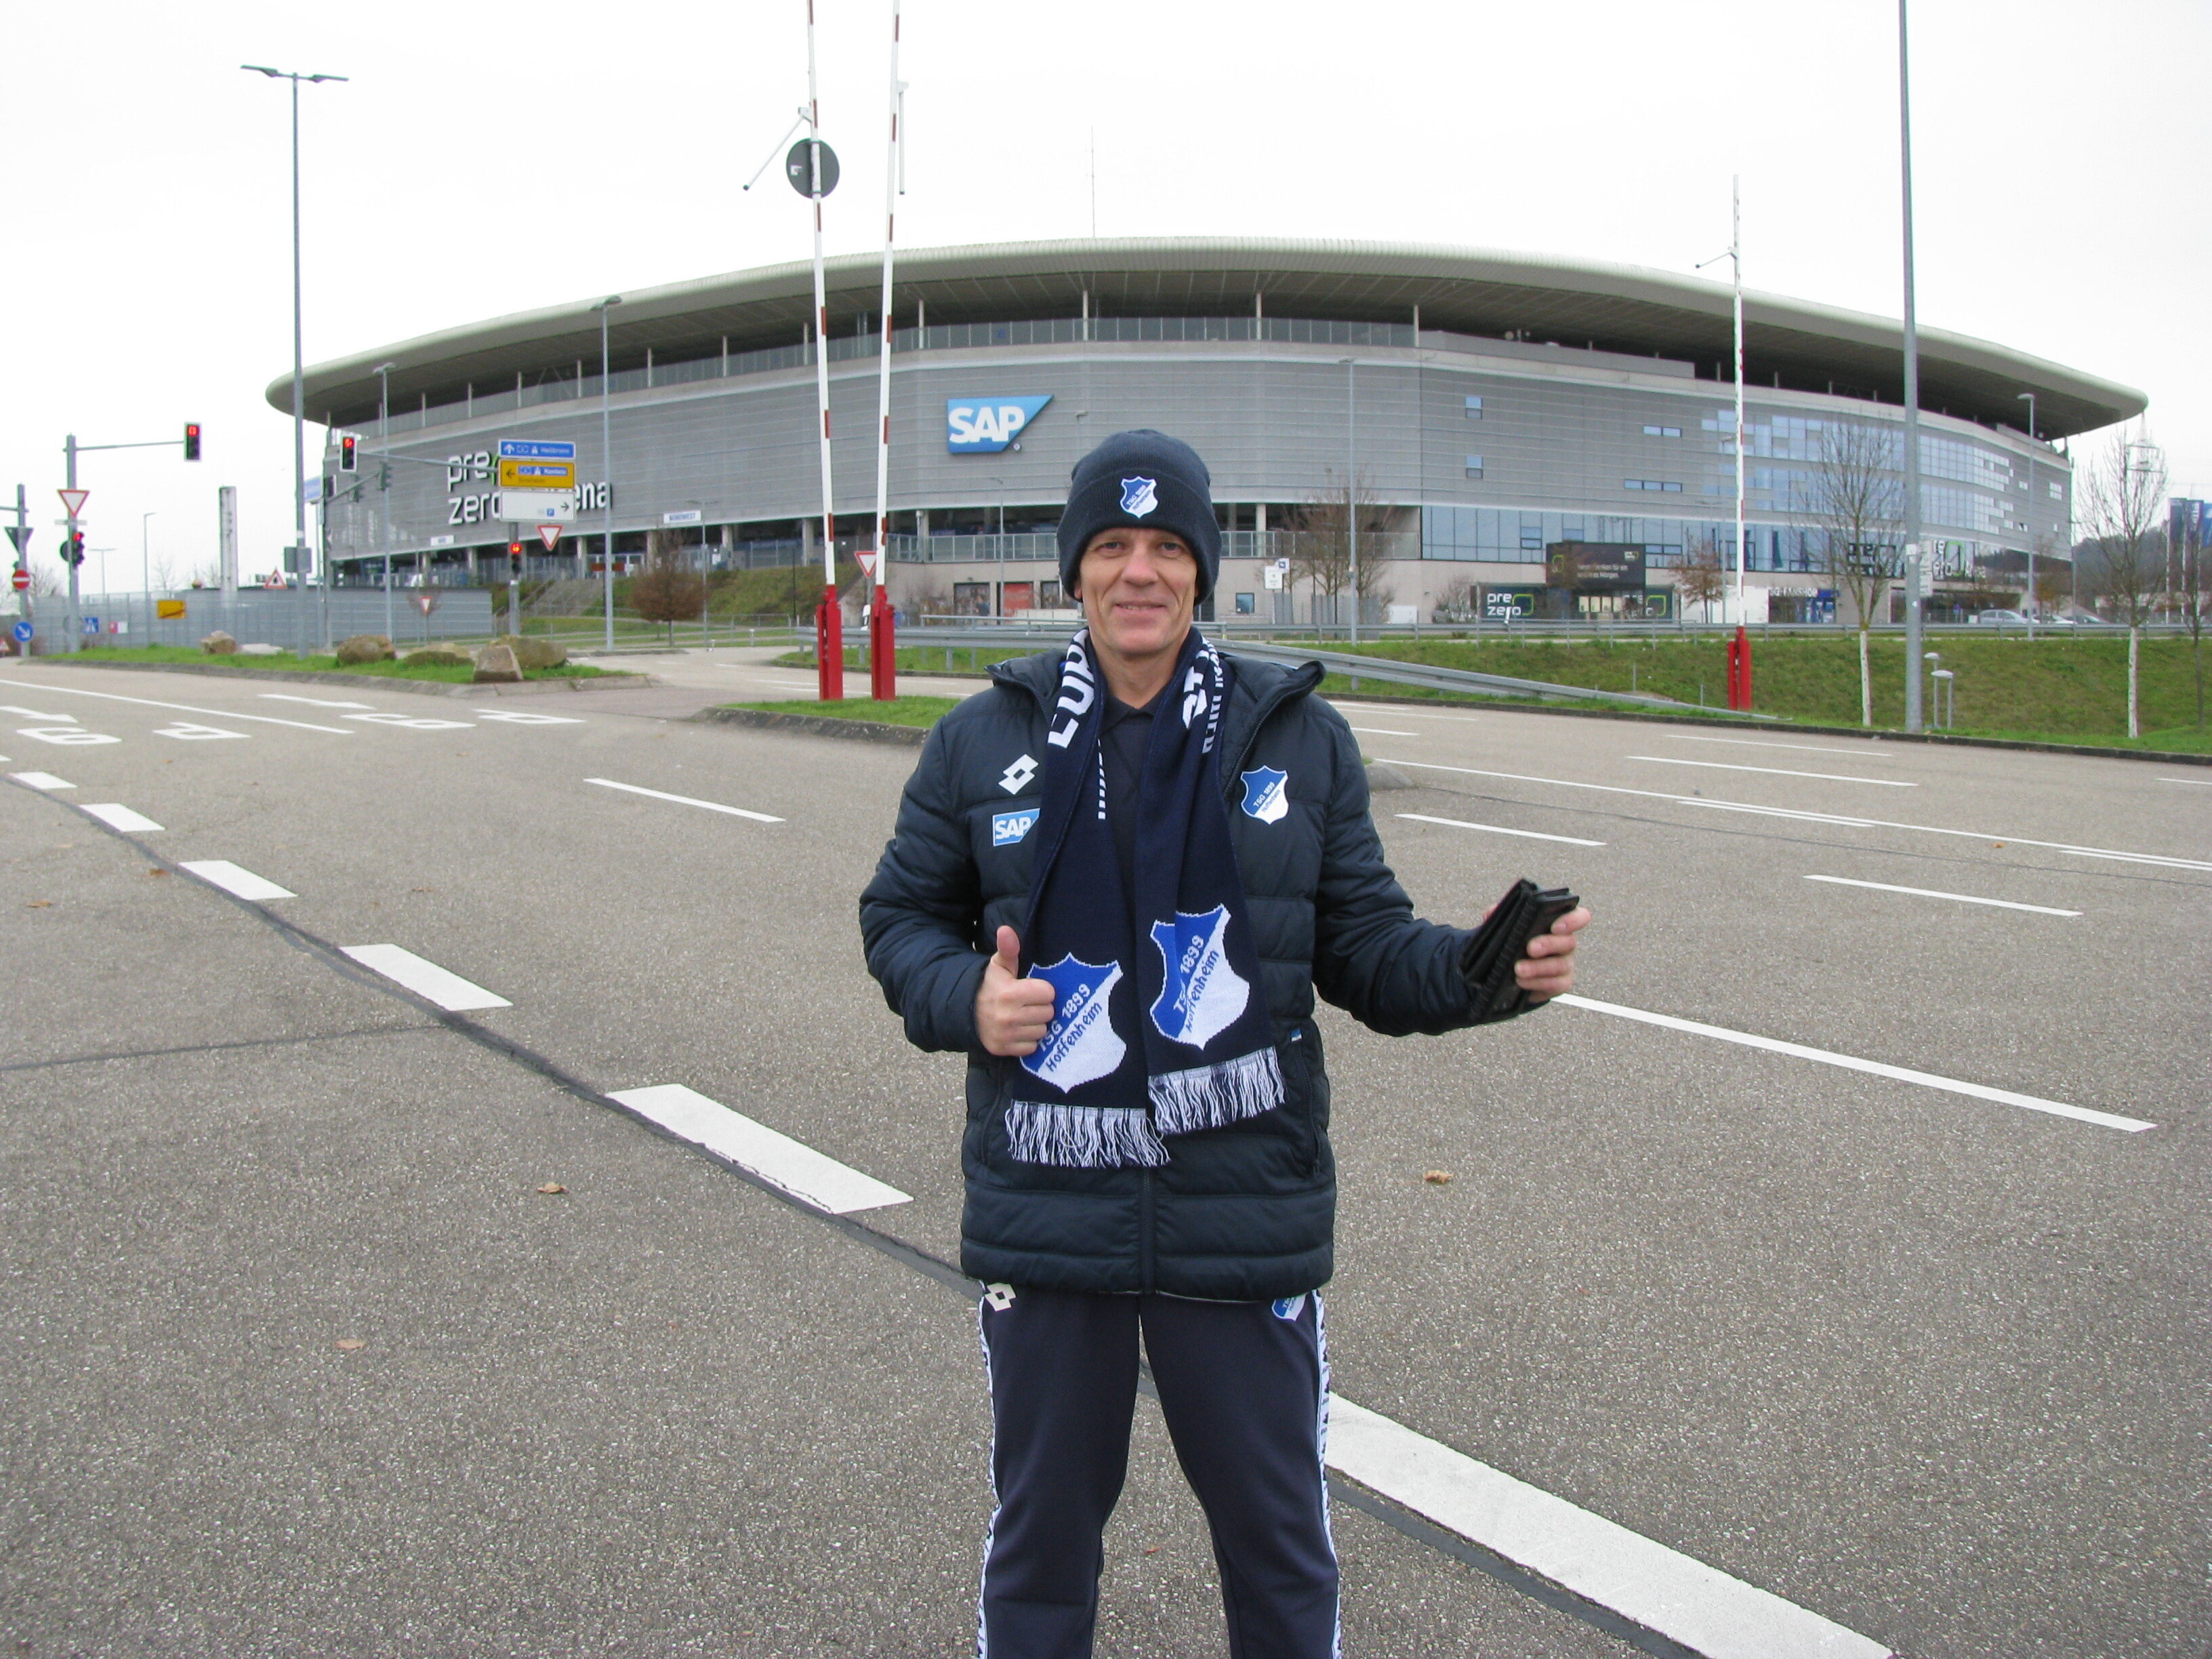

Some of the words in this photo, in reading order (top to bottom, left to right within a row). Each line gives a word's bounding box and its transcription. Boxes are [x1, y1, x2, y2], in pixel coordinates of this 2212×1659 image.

[949, 406, 1025, 443] SAP
[448, 451, 489, 493] pre
[1487, 593, 1512, 605] pre
[1252, 794, 1266, 807] TSG
[995, 817, 1031, 840] SAP
[1180, 935, 1204, 974] 1899
[1061, 983, 1090, 1019] 1899
[1046, 1002, 1103, 1073] Hoffenheim
